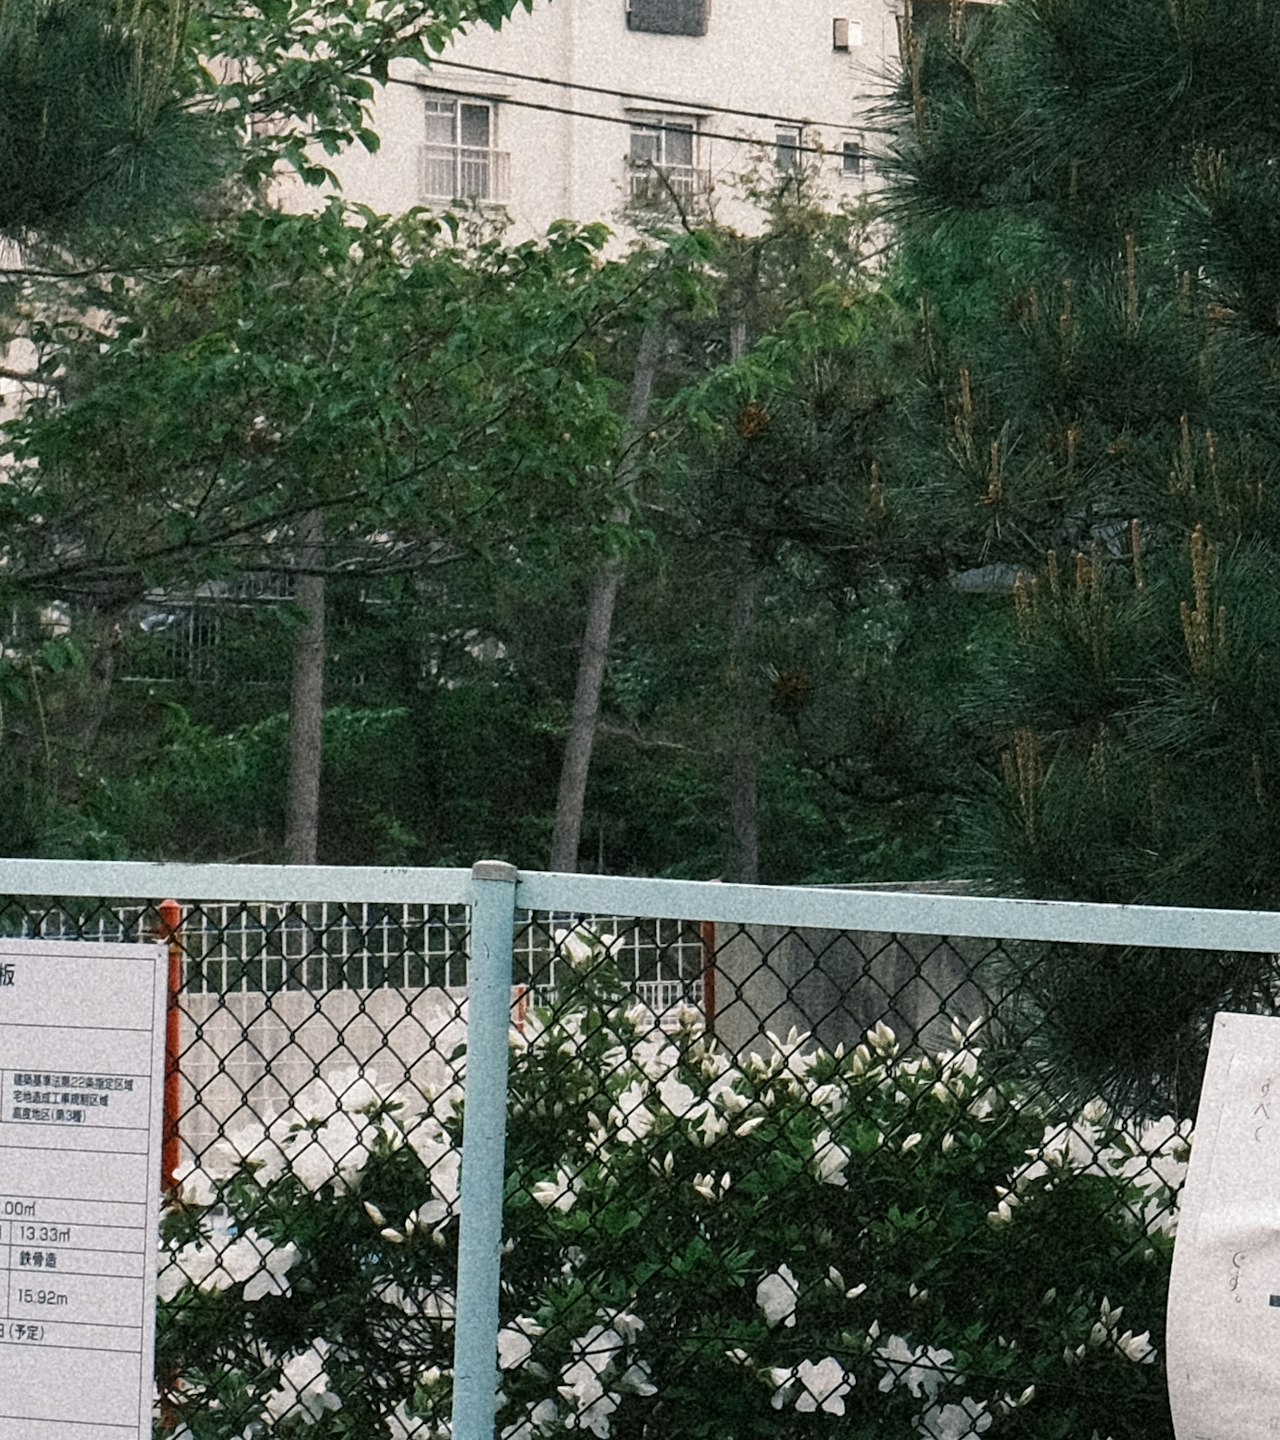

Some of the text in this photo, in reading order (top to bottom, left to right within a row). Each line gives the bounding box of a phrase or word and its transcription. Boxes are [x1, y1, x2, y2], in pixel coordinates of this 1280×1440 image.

[19, 1250, 57, 1268] 鉄骨造
[18, 1288, 68, 1306] 15.92m
